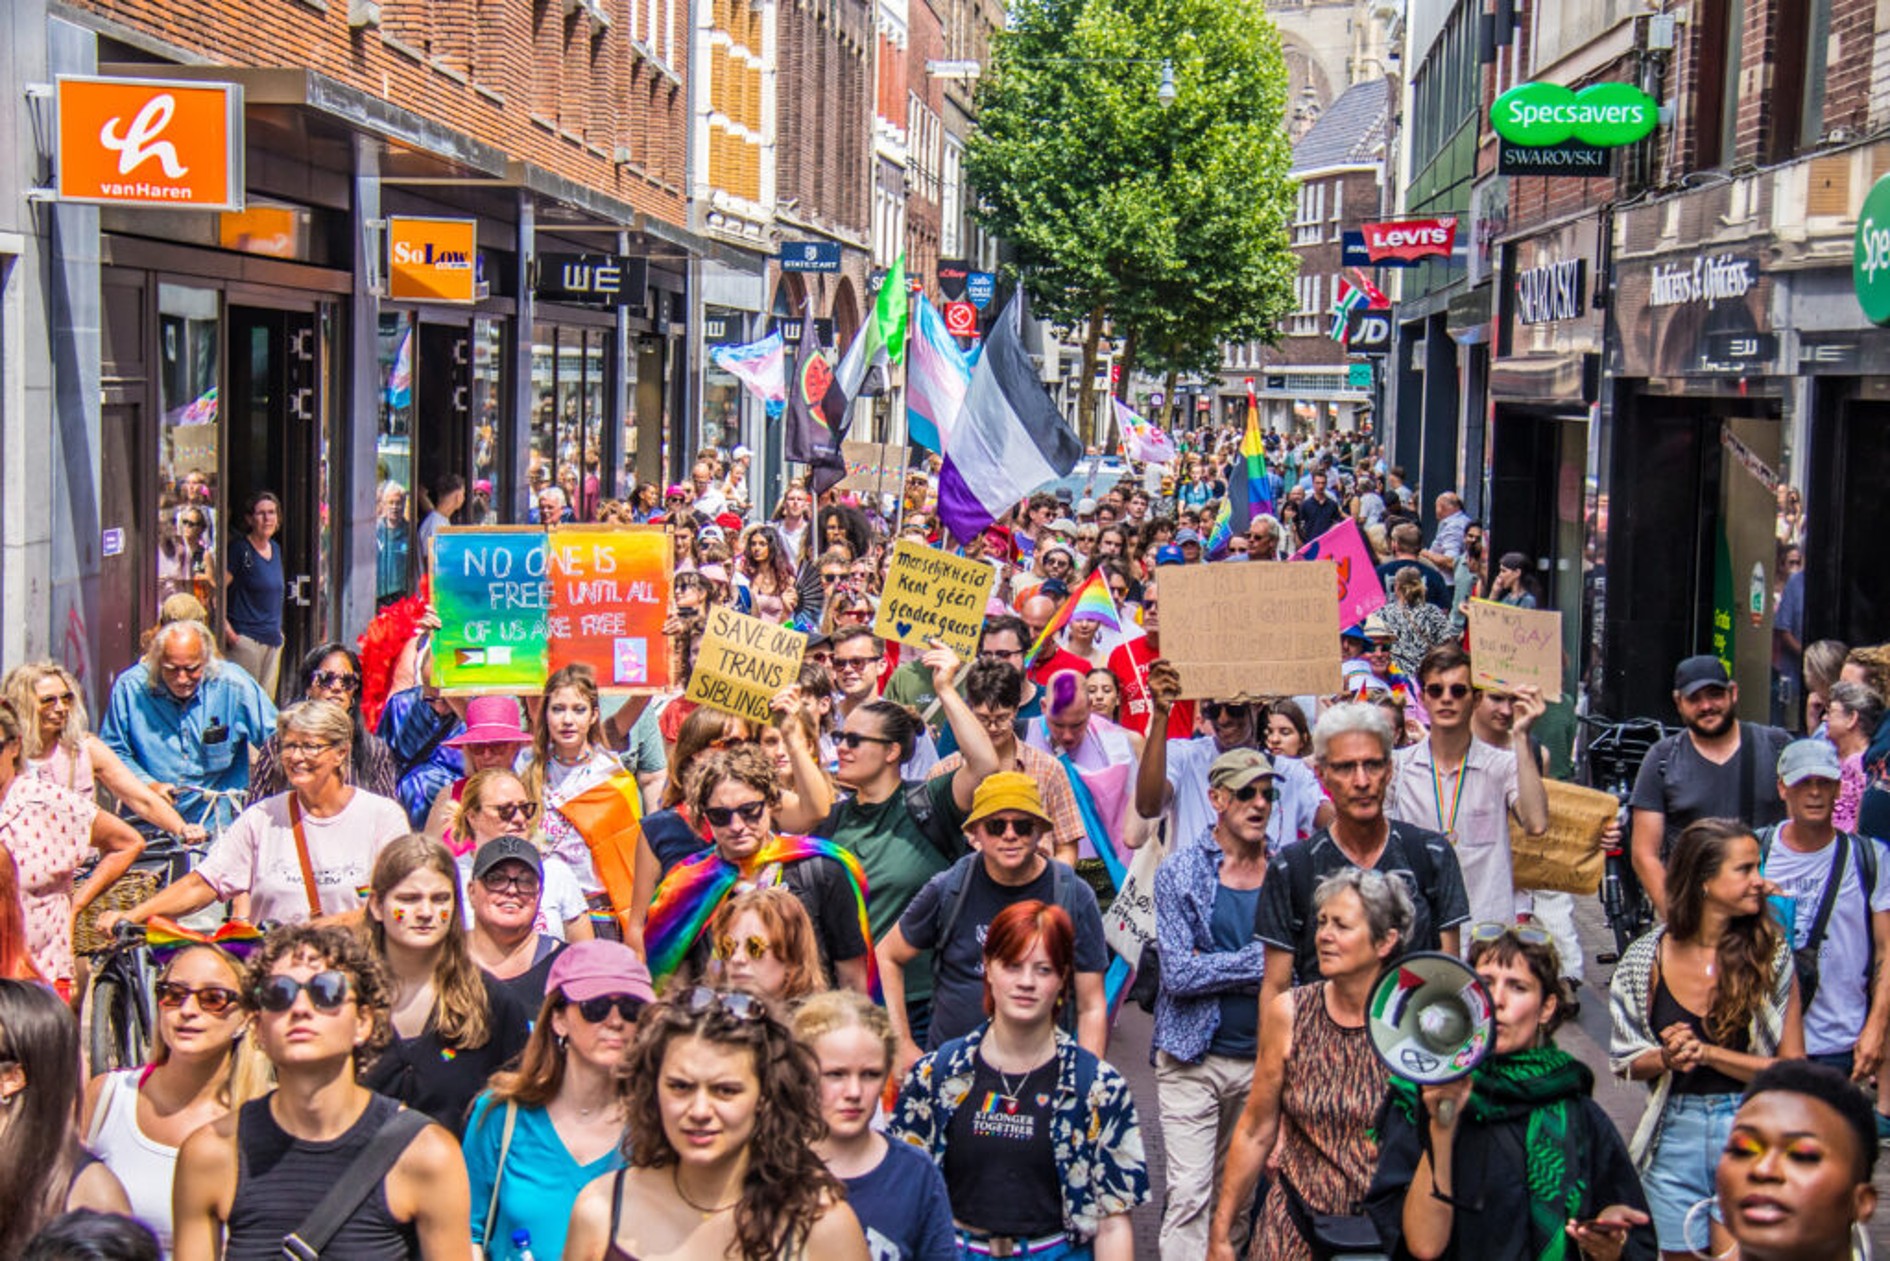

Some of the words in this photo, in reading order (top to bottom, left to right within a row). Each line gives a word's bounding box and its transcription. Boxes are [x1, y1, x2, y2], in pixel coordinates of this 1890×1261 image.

[1508, 99, 1644, 128] Specsavers
[1504, 149, 1604, 165] SWAROVSKI
[101, 183, 192, 199] vanHaren
[563, 264, 621, 292] WE
[1350, 317, 1389, 345] JD
[463, 547, 512, 578] NO
[525, 546, 584, 577] ONE
[593, 545, 617, 574] IS
[488, 581, 557, 610] FREE
[568, 579, 623, 605] UNTIL
[626, 580, 660, 604] ALL
[463, 619, 492, 643] OF
[499, 618, 527, 640] US
[530, 615, 572, 640] ARE
[581, 612, 627, 637] FREE
[713, 612, 767, 650] SAVE
[770, 630, 802, 660] OUR
[1513, 628, 1553, 650] GAY
[719, 647, 783, 688] TRANS
[695, 674, 773, 721] SIBLINGS
[973, 1121, 1034, 1135] TOGETHER
[974, 1111, 1034, 1125] STRONGER
